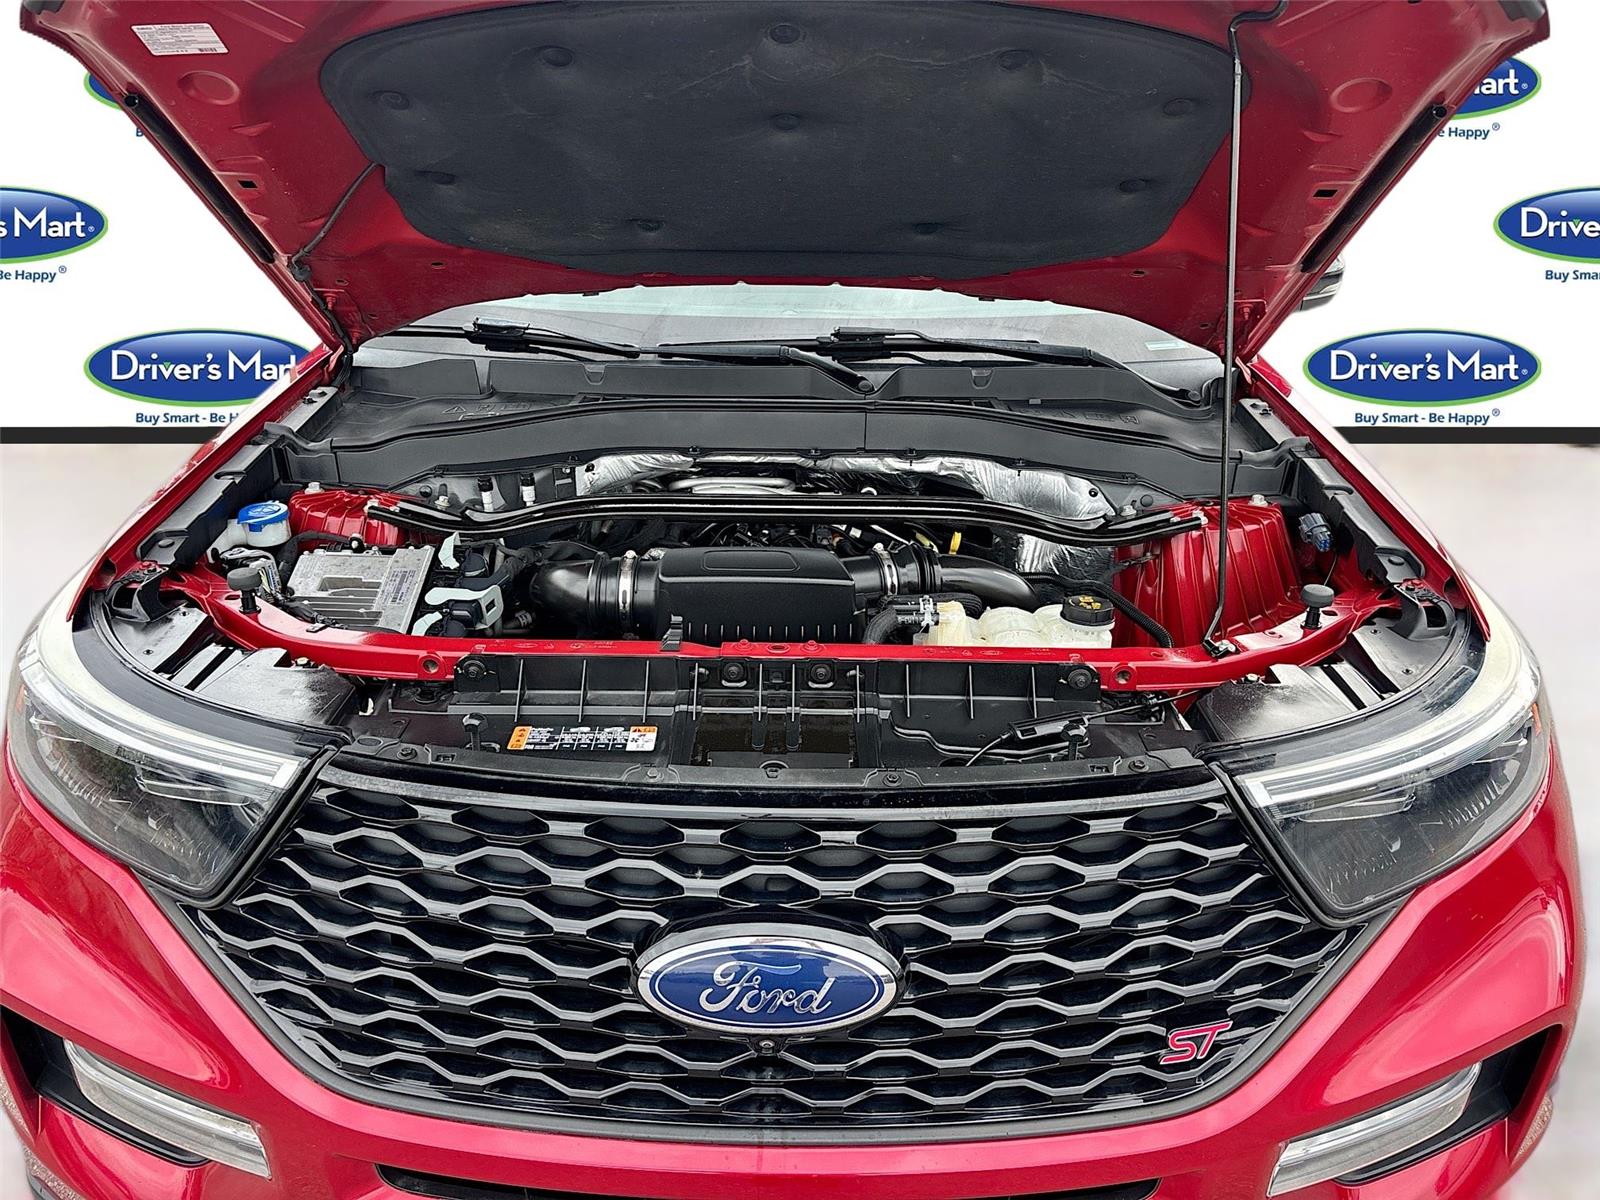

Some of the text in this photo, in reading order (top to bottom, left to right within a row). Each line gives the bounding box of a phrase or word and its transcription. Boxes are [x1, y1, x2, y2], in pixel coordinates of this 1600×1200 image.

[1474, 69, 1519, 94] art
[1448, 127, 1490, 140] Happy
[14, 206, 86, 237] Mart
[15, 270, 56, 283] Happy
[1545, 270, 1570, 283] Buy
[111, 350, 222, 381] Driver's
[1330, 350, 1519, 381] Driver's Mart
[136, 413, 160, 425] Buy
[163, 413, 199, 423] Smart
[209, 413, 226, 423] Be
[1355, 413, 1379, 425] Buy
[1382, 413, 1418, 423] Smart
[1429, 413, 1445, 423] Be
[1448, 413, 1490, 426] Happy
[699, 960, 835, 1014] Ford
[1159, 1020, 1233, 1064] ST
